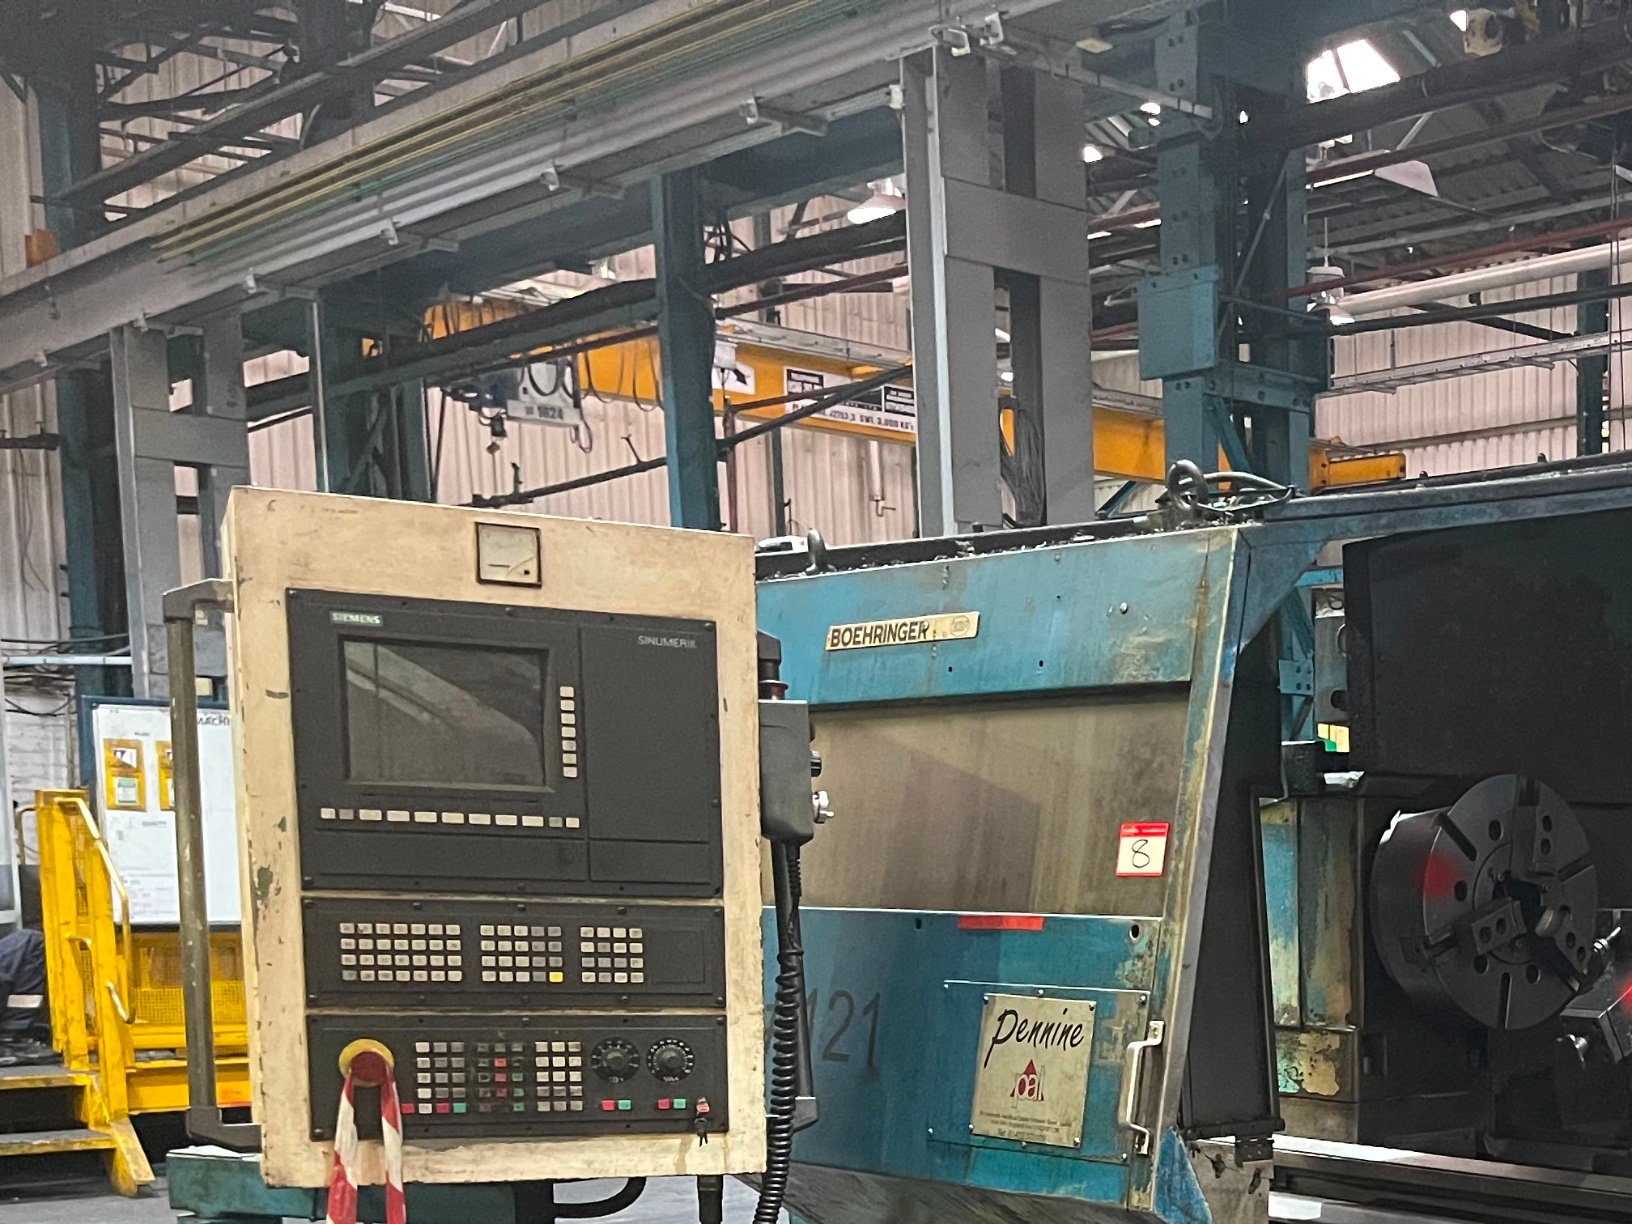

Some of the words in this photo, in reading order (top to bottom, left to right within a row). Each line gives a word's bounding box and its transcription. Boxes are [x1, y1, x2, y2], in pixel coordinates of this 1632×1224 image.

[332, 612, 381, 624] SIEMENS
[638, 635, 697, 649] SINUMERIK
[830, 620, 930, 648] BOEHRINGER
[1131, 838, 1151, 869] 8
[983, 1007, 1085, 1069] Pennine
